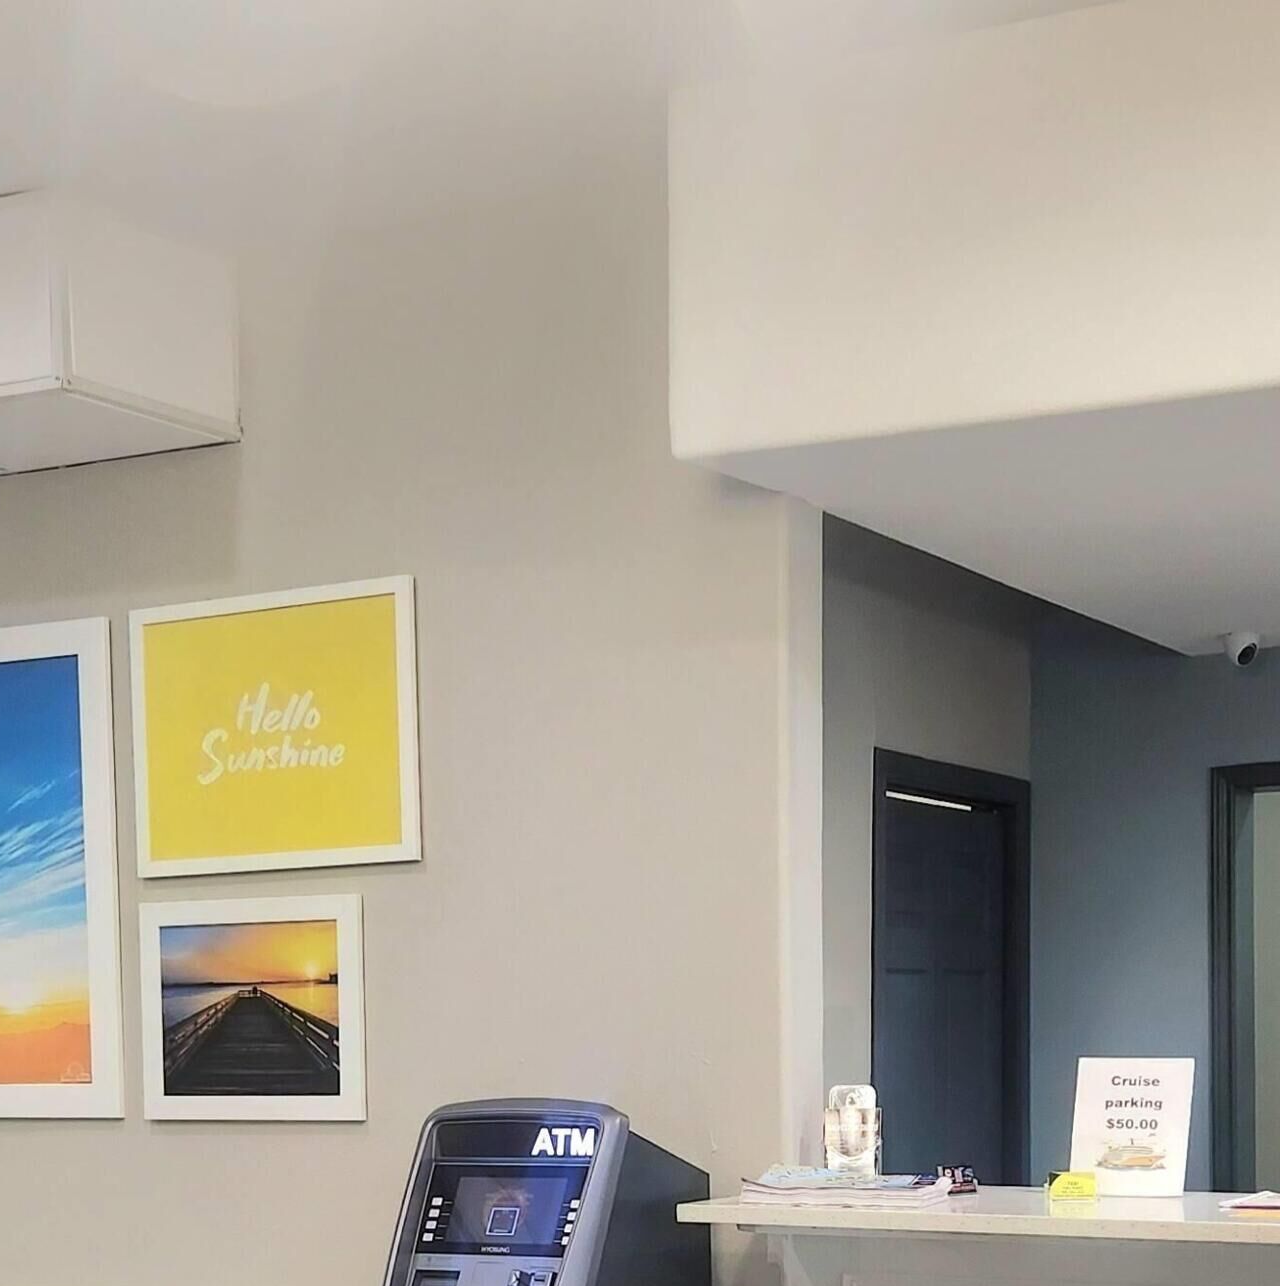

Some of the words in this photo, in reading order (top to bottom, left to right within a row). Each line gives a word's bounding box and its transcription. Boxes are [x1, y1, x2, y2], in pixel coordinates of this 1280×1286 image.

[236, 682, 320, 735] Hello
[197, 728, 346, 785] Sunshine
[1111, 1075, 1161, 1087] Cruise
[1105, 1097, 1163, 1111] parking
[1106, 1117, 1158, 1130] $50.00
[531, 1127, 595, 1156] ATM
